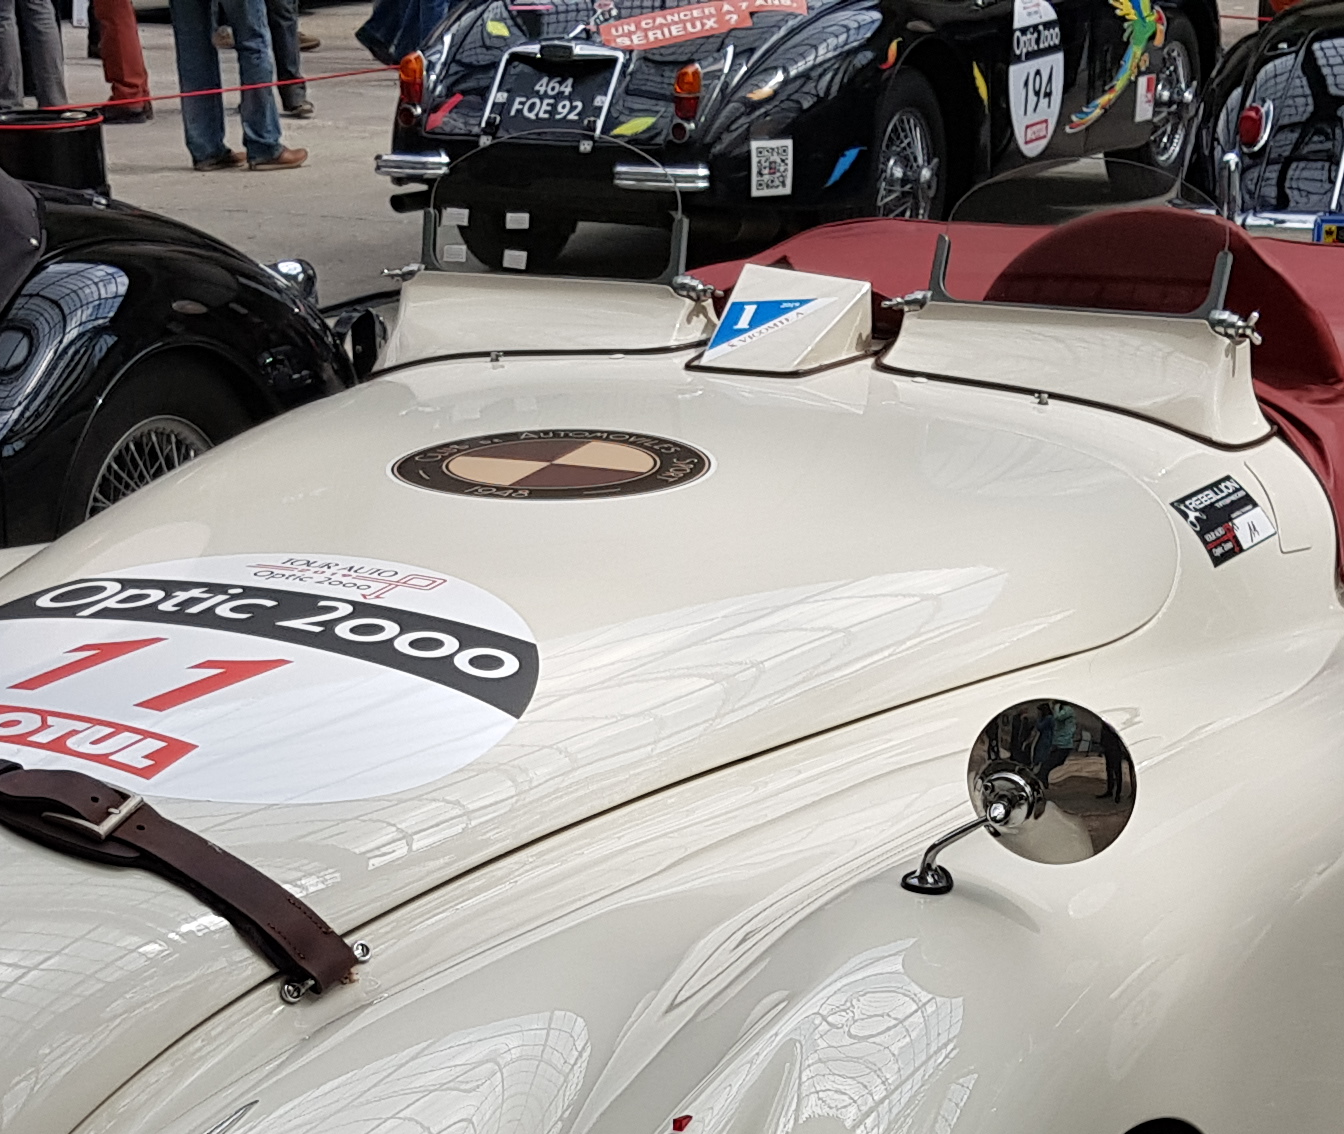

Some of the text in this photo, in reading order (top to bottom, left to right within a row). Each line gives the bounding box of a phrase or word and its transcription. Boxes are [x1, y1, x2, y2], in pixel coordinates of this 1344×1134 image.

[611, 22, 636, 36] UN
[640, 7, 716, 29] CANCER
[616, 17, 719, 46] SÉRIEUX
[1013, 27, 1038, 61] Optic
[534, 76, 574, 96] 464
[1022, 64, 1054, 117] 194
[510, 96, 583, 120] FQE 92
[733, 304, 758, 329] 1
[519, 431, 682, 455] AUTOMOVILES
[463, 485, 532, 498] 1948
[1185, 478, 1240, 511] REBELLION
[253, 569, 372, 591] Optic 2000
[281, 557, 399, 578] TOUR AUTO
[35, 579, 521, 680] Optic 2000
[6, 637, 294, 712] 11
